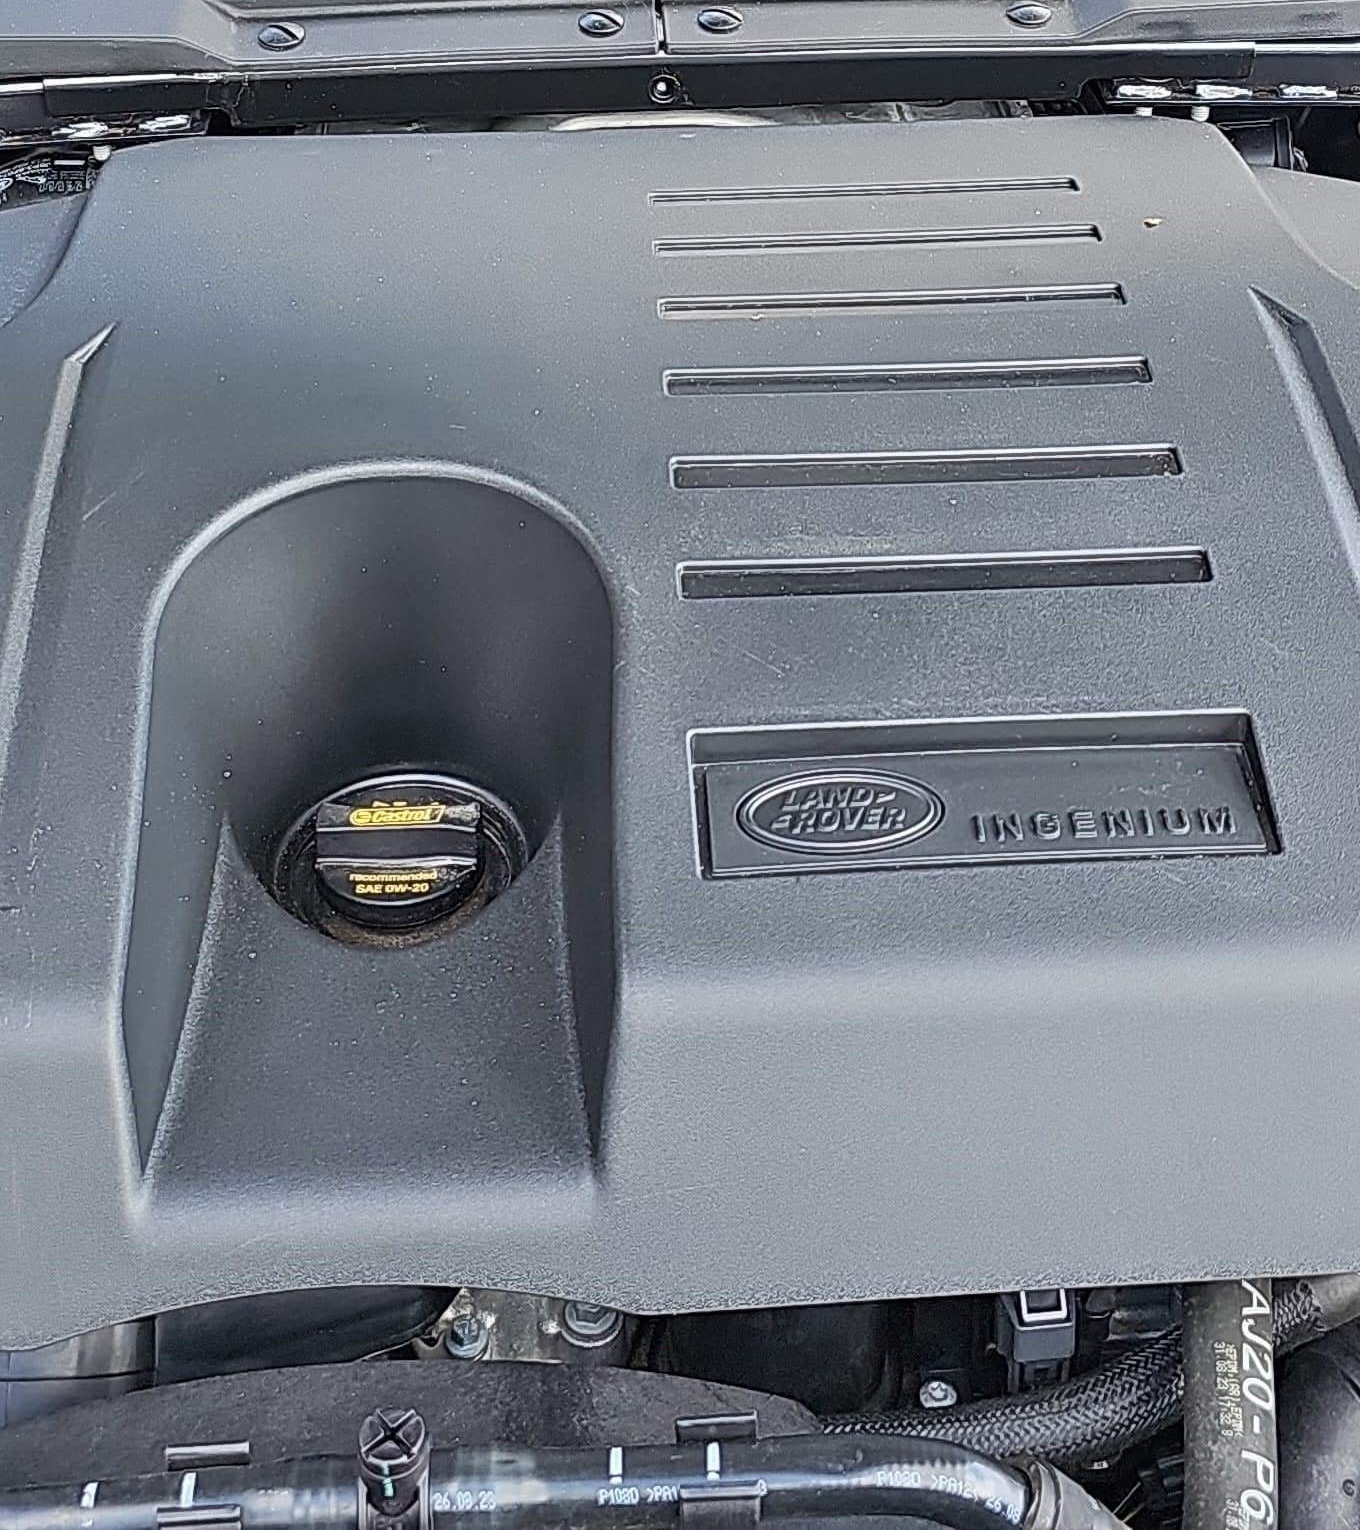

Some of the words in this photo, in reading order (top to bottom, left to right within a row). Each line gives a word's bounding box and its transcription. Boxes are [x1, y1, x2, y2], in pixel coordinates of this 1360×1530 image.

[782, 786, 875, 812] LAND
[371, 808, 433, 823] Castrol
[791, 807, 907, 835] ROVER
[972, 804, 1238, 844] INGENIUM
[349, 870, 437, 882] recommended
[355, 884, 383, 894] SAE
[384, 882, 430, 894] 0W-20
[1241, 1449, 1275, 1526] P6
